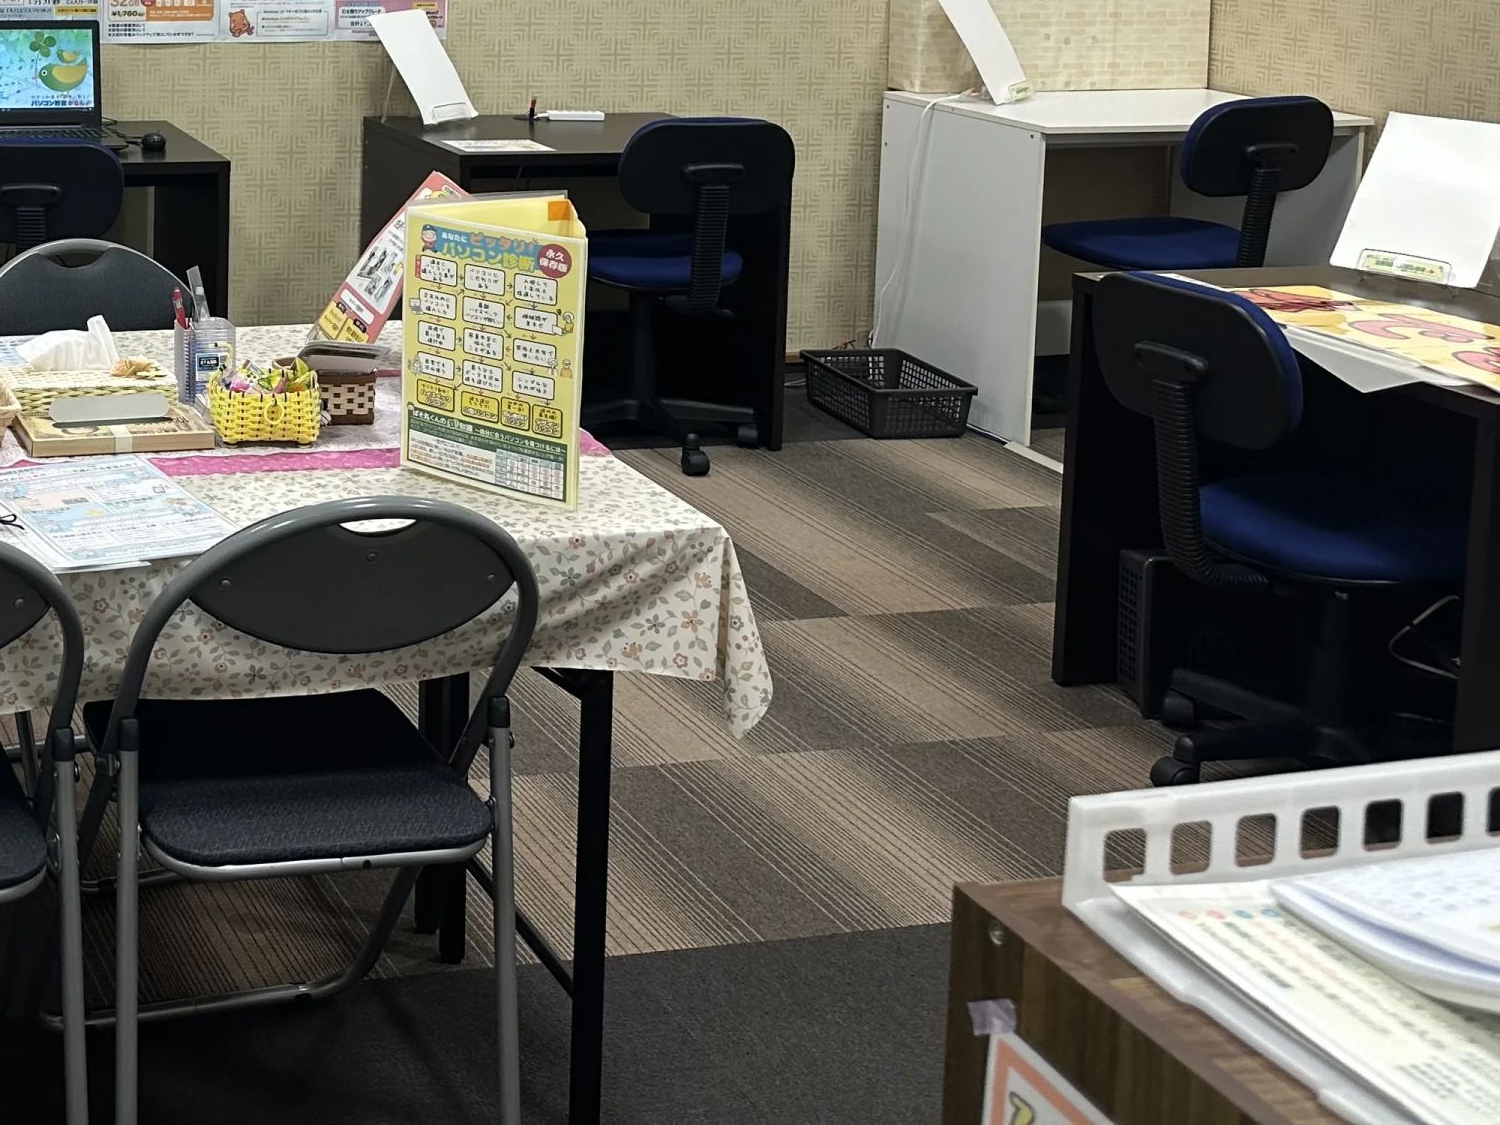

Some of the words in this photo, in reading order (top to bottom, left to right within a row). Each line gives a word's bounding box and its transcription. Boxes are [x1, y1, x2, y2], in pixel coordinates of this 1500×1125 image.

[442, 233, 468, 243] あなたに
[441, 242, 535, 273] パソコン診断
[546, 249, 564, 262] 永久
[540, 258, 568, 273] 保存版
